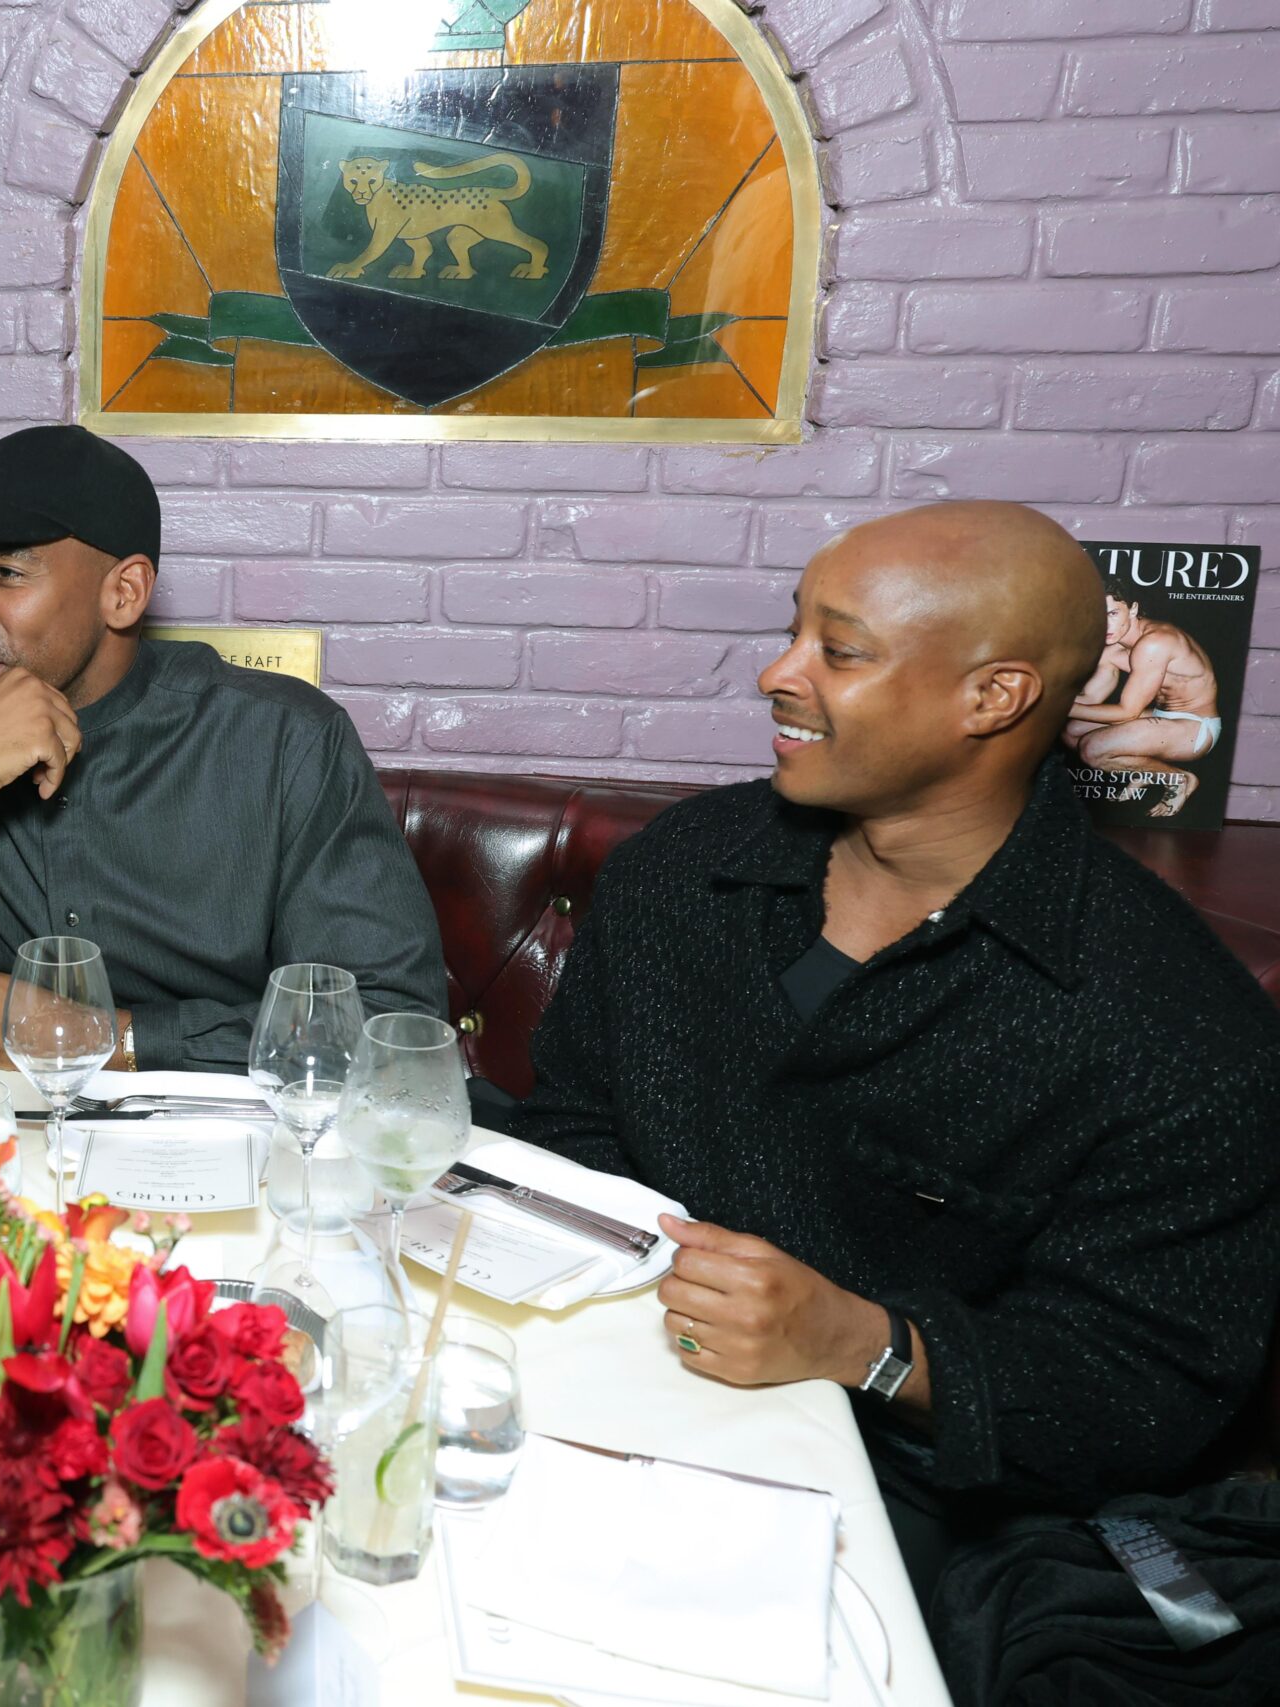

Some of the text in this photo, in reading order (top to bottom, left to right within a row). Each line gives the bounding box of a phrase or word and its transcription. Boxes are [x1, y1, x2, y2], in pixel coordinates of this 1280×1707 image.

[1099, 549, 1249, 589] TURED
[1168, 592, 1245, 602] THE ENTERTAINERS
[245, 655, 283, 668] RAFT
[1066, 768, 1185, 786] NOR STORRIE
[1073, 785, 1147, 801] ETS RAW
